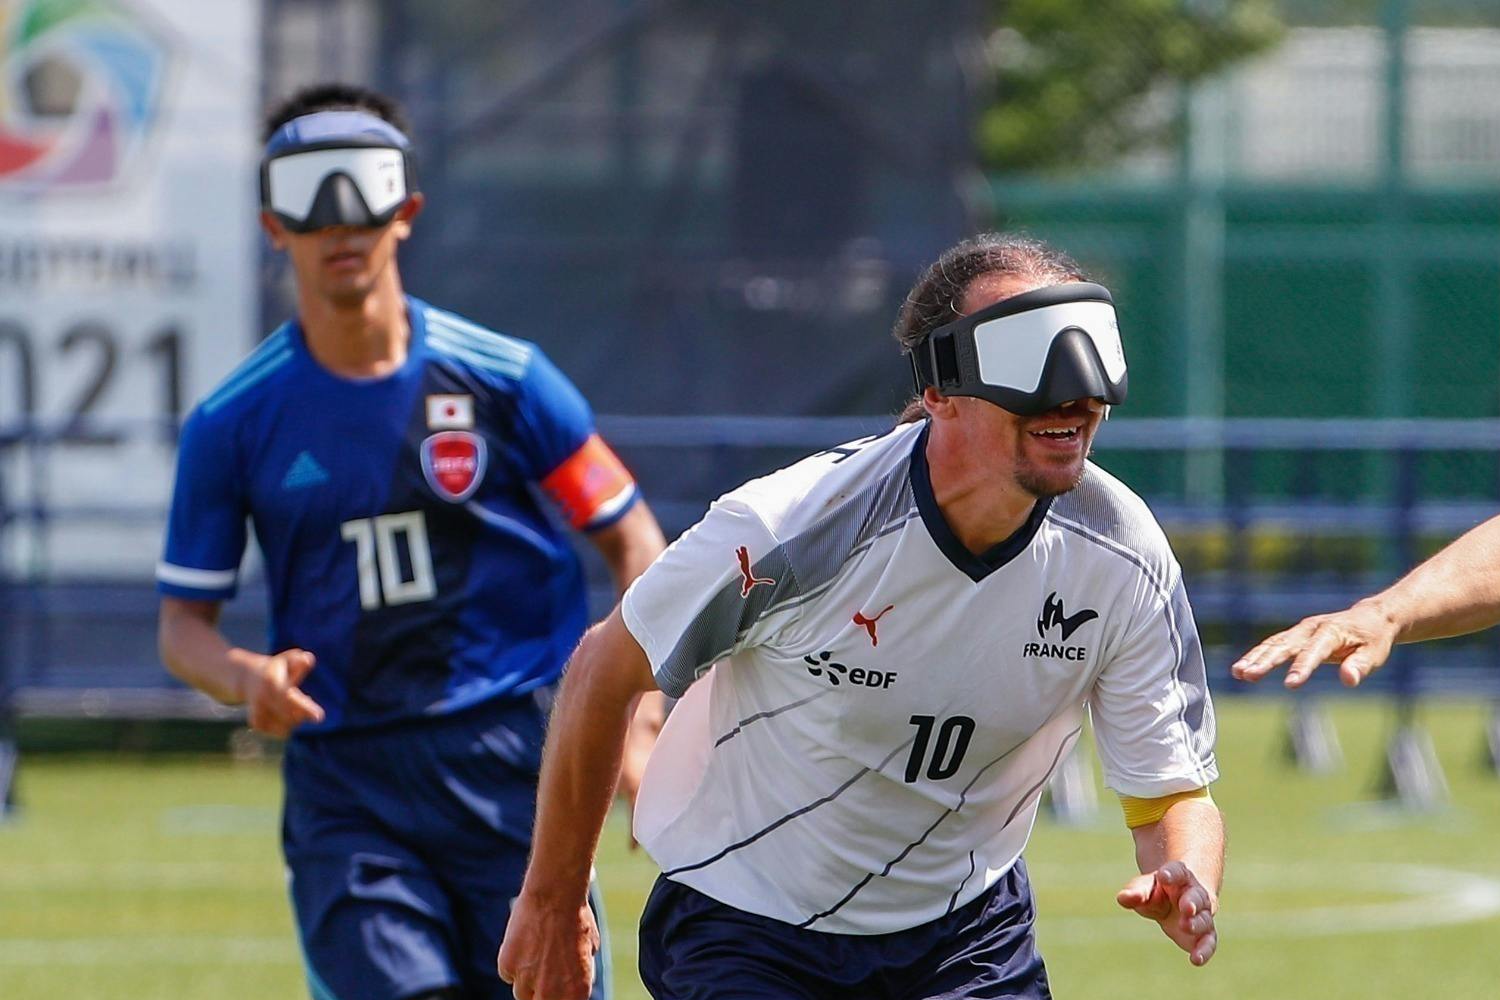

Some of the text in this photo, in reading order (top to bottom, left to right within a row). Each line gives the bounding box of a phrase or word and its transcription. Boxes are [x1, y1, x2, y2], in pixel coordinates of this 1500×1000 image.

[340, 510, 437, 611] 10
[1023, 643, 1086, 661] FRANCE
[904, 714, 976, 784] 10
